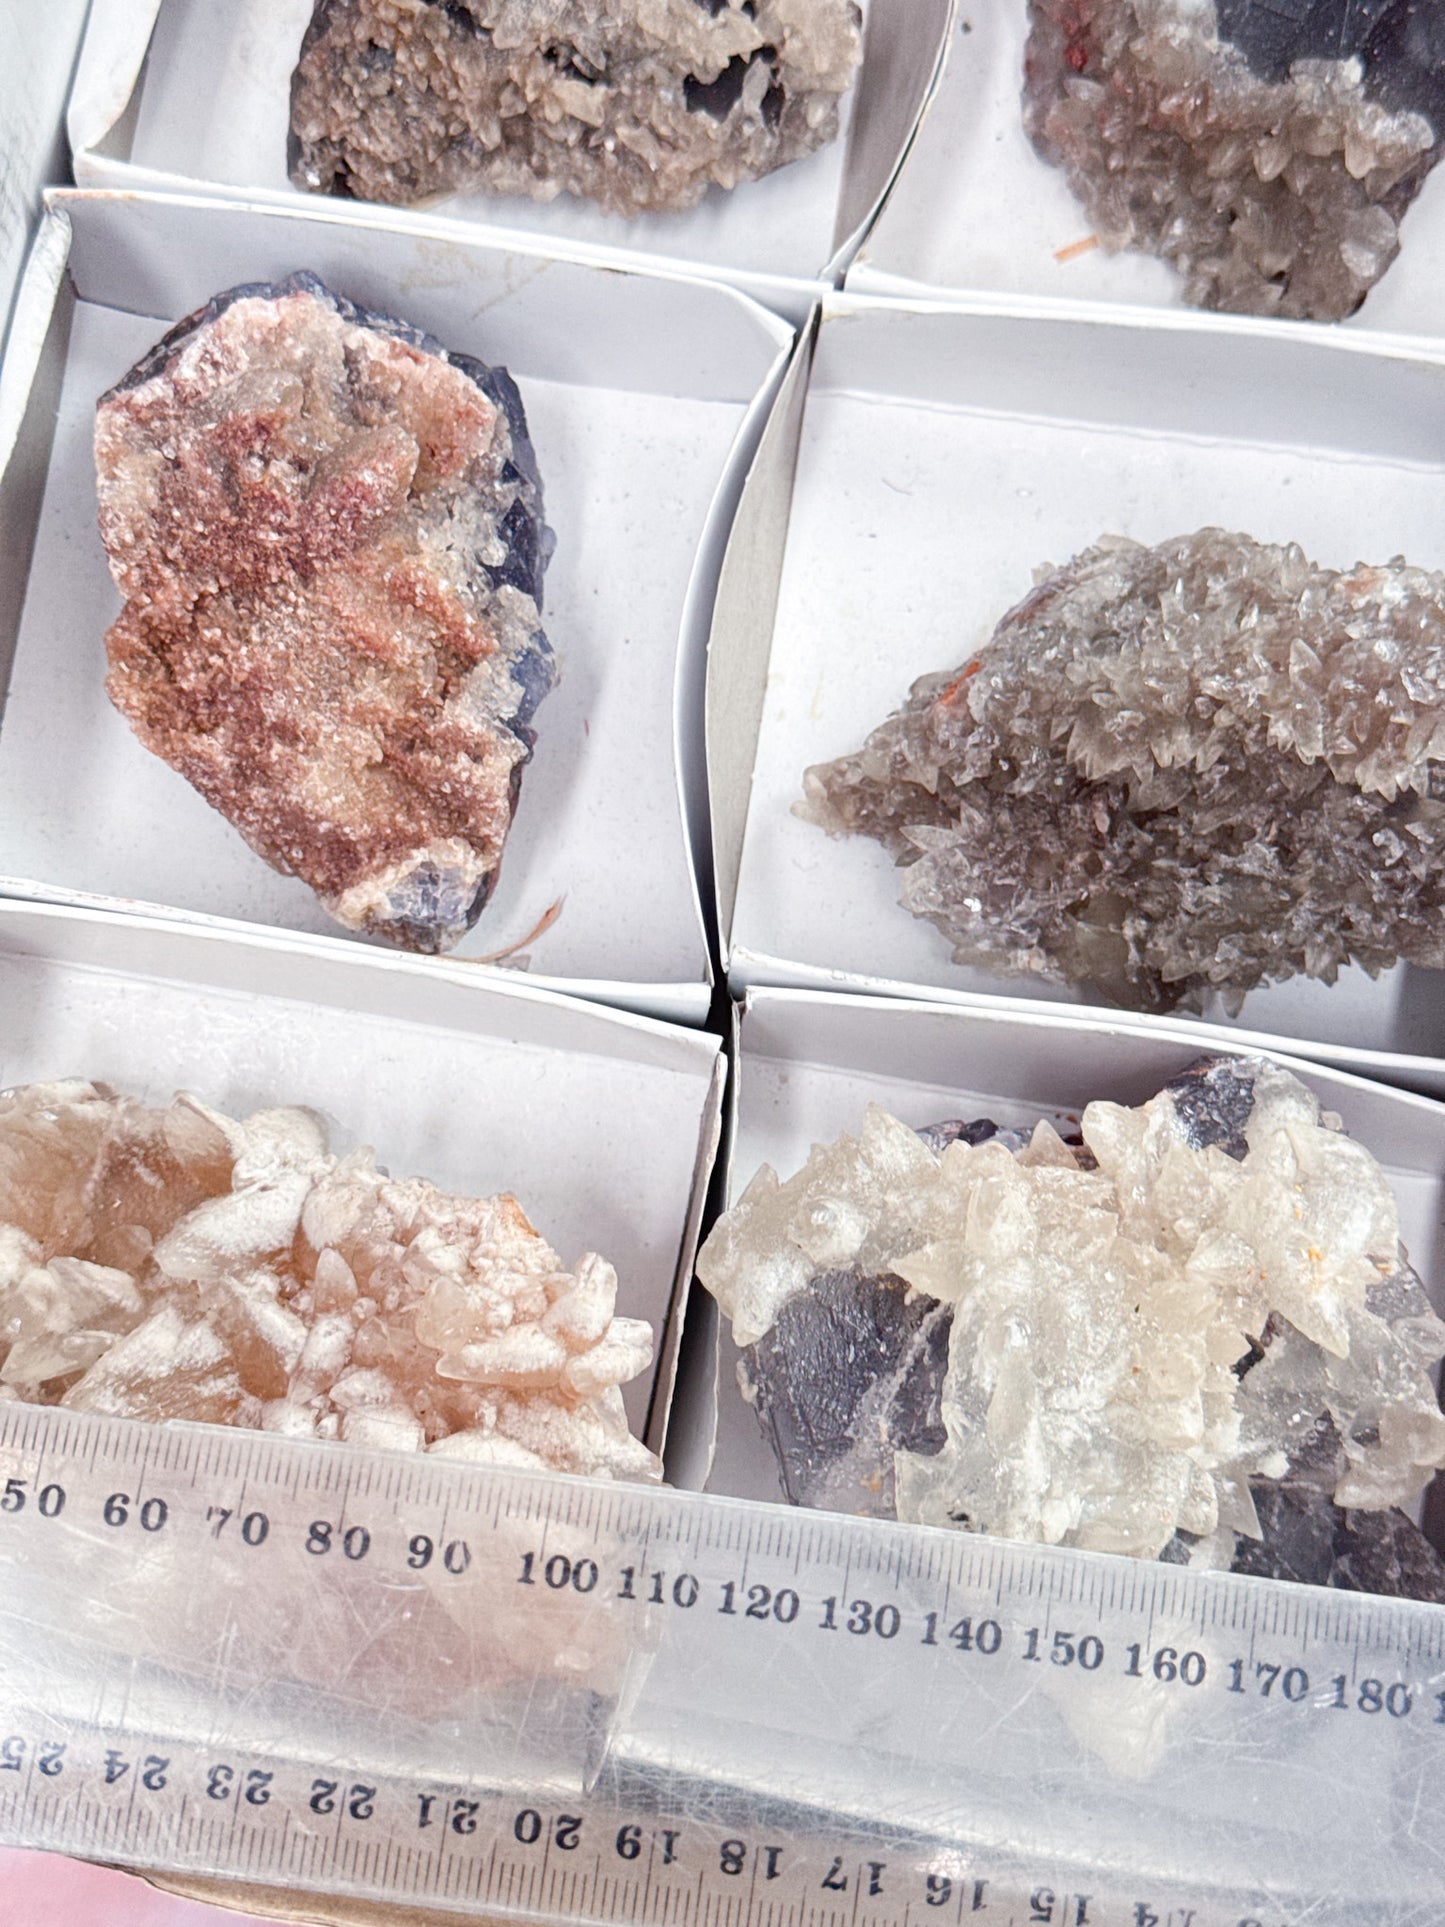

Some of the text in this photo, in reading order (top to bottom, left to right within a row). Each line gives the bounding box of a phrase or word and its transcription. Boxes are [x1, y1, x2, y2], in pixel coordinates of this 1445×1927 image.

[1, 1478, 67, 1518] 50
[103, 1493, 168, 1532] 60
[206, 1506, 270, 1546] 70
[304, 1520, 371, 1560] 80
[406, 1535, 472, 1574] 90
[516, 1551, 599, 1592] 100
[616, 1567, 699, 1608] 110
[717, 1582, 800, 1623] 120
[818, 1596, 901, 1639] 130
[920, 1612, 1002, 1655] 140
[1021, 1627, 1104, 1670] 150
[1123, 1643, 1206, 1686] 160
[1226, 1658, 1309, 1702] 170
[1329, 1674, 1413, 1718] 180
[0, 1735, 68, 1776] 25
[103, 1749, 170, 1790] 24
[206, 1764, 273, 1805] 23
[308, 1778, 377, 1820] 22
[416, 1792, 481, 1835] 21
[514, 1808, 584, 1851] 20
[615, 1823, 682, 1865] 19
[718, 1839, 784, 1881] 18
[821, 1855, 888, 1897] 17
[926, 1871, 990, 1912] 16
[1030, 1886, 1094, 1927] 15
